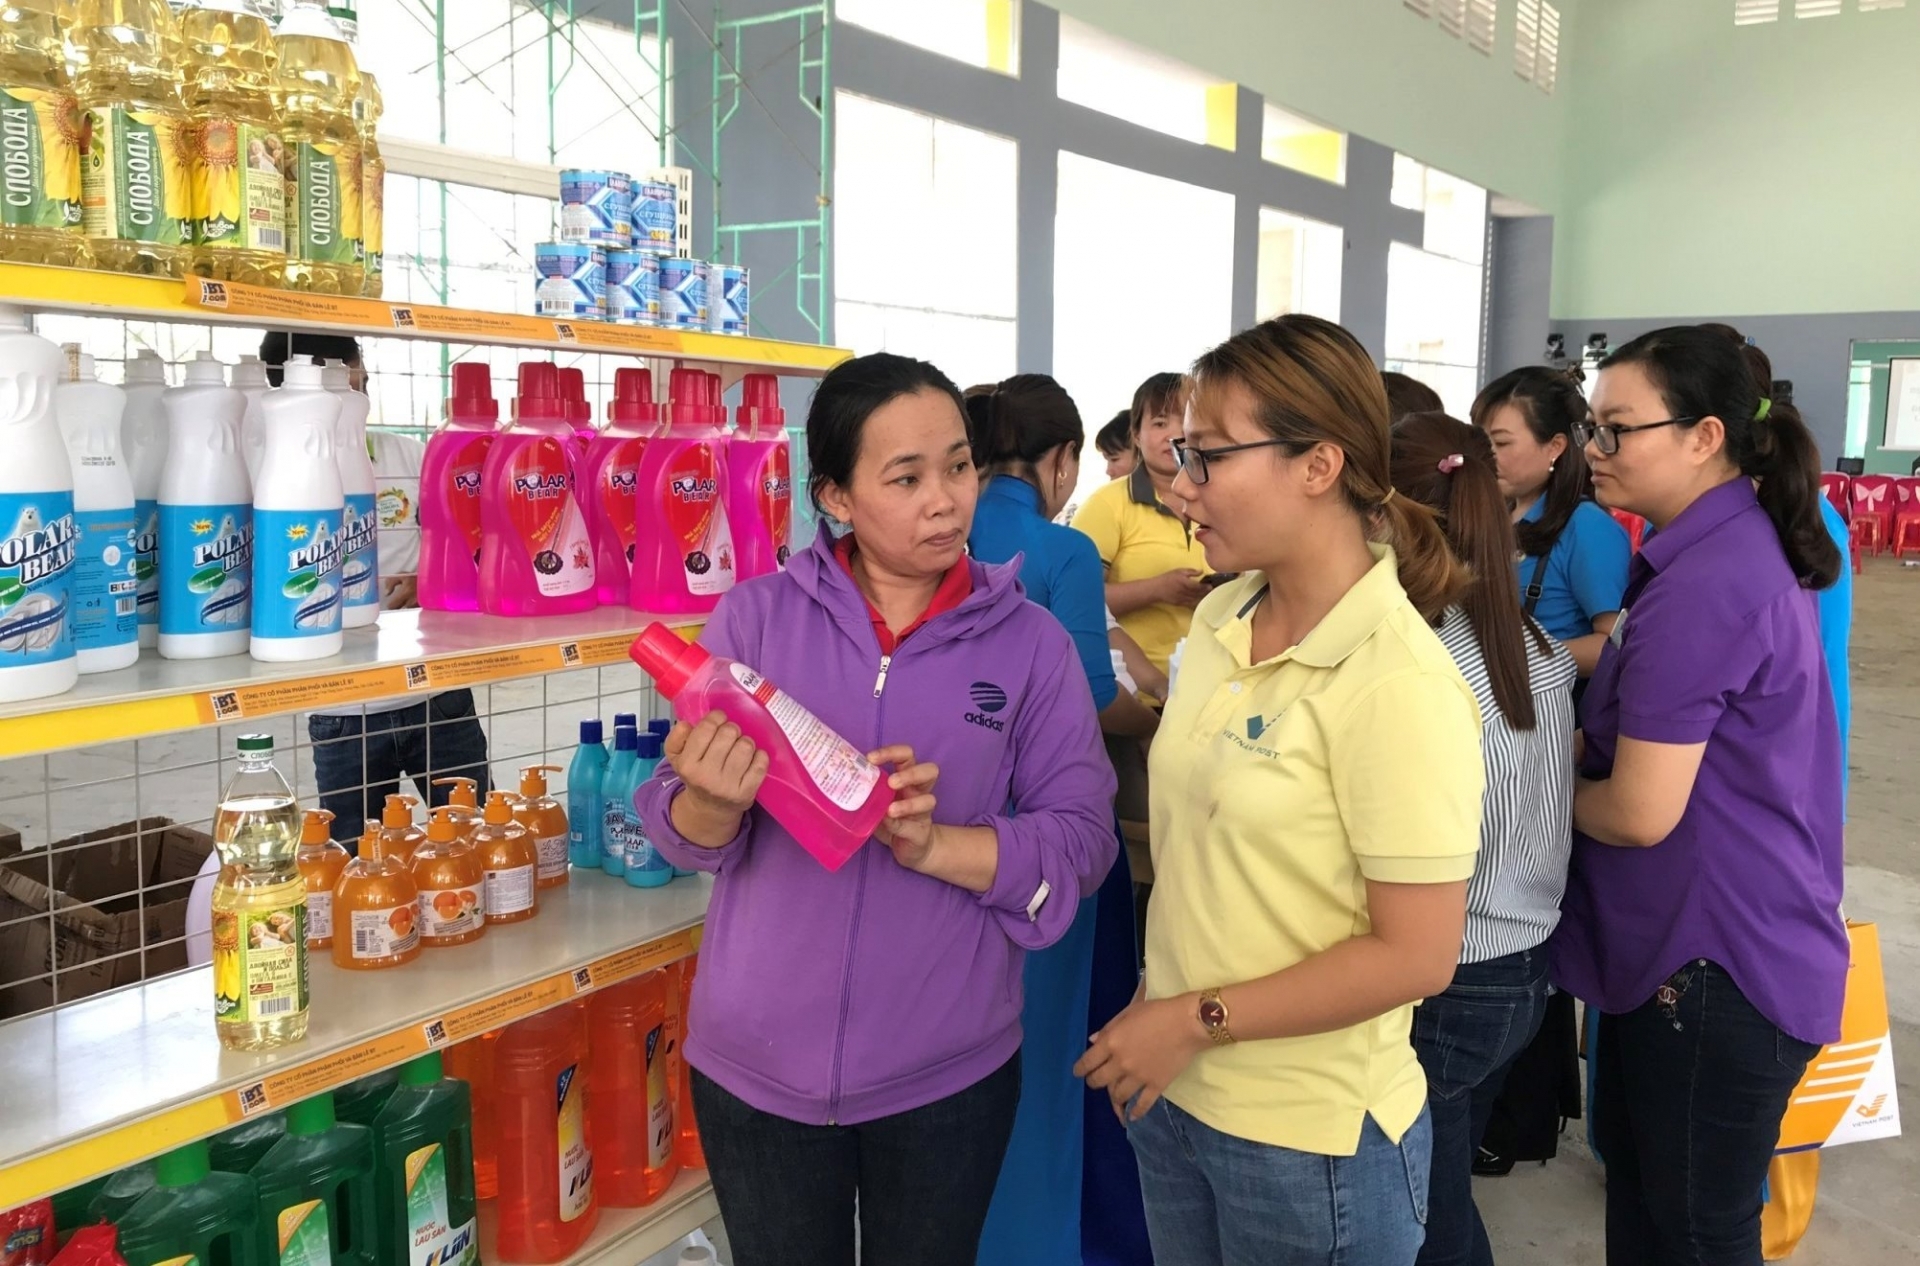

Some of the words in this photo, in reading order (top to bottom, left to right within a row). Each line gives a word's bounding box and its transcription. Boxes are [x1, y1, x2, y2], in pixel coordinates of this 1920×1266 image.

[3, 108, 32, 207] СЛОБОДА
[127, 131, 153, 225] СЛОБОДА
[310, 160, 331, 245] СЛОБОДА
[515, 474, 566, 492] POLAR
[672, 477, 716, 494] POLAR
[528, 489, 558, 499] BEAR
[684, 492, 710, 501] BEAR
[0, 515, 73, 567] OLAR
[225, 541, 252, 572] BEA
[217, 692, 236, 708] BT
[964, 712, 1004, 732] adidas
[1223, 729, 1255, 752] VIETNAM
[1255, 746, 1281, 759] POST
[245, 1084, 263, 1103] BT
[415, 1234, 431, 1247] LAU
